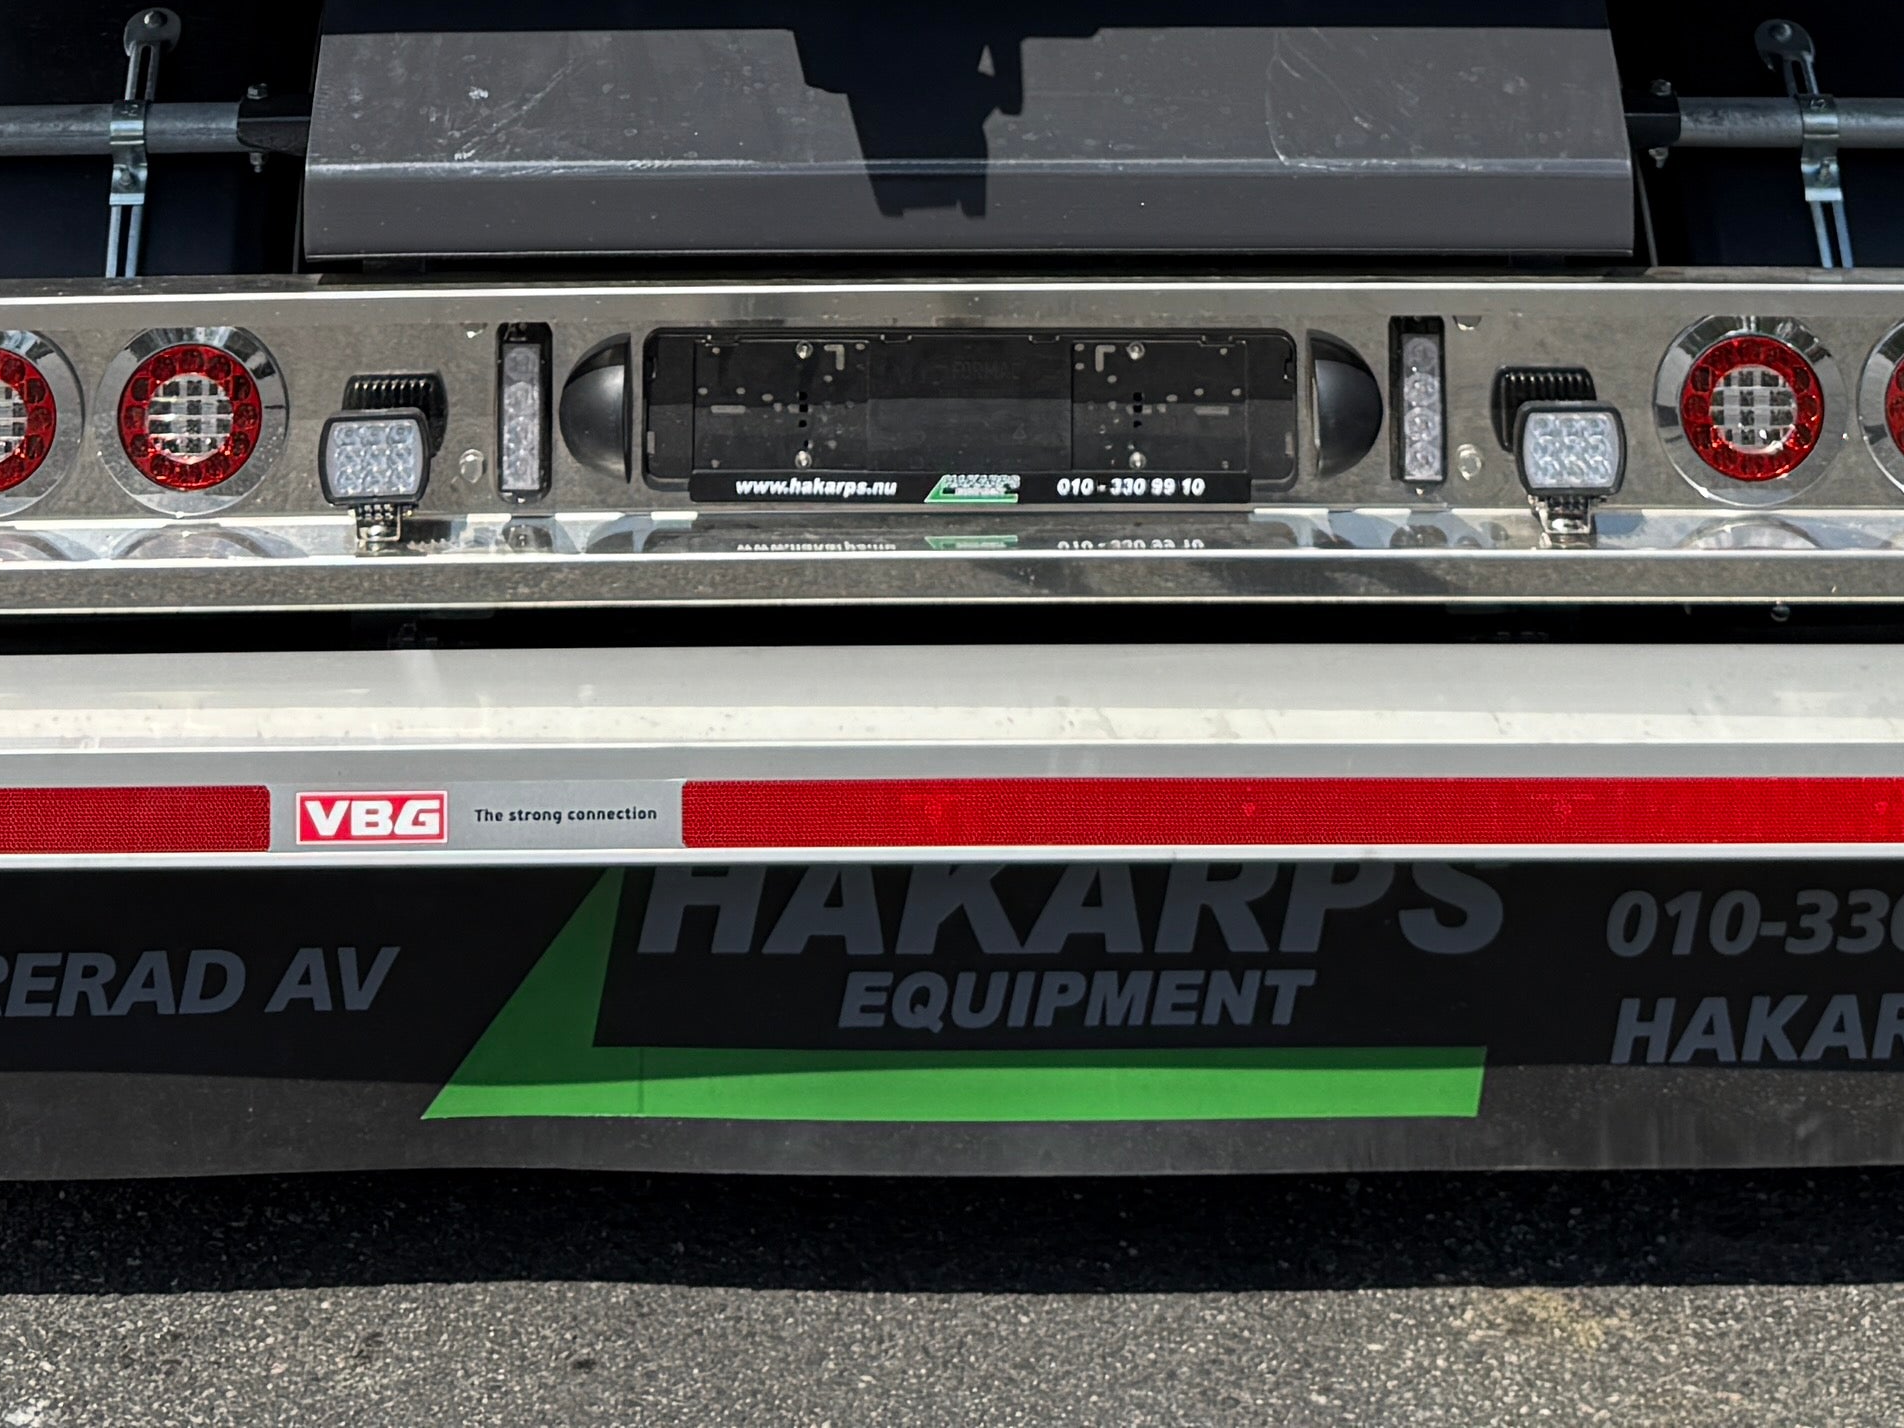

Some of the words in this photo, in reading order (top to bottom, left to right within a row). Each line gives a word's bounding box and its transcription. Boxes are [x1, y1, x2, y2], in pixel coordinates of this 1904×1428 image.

[735, 477, 898, 498] www.hakarps.nu
[1109, 478, 1147, 496] 330
[1151, 478, 1176, 496] 99
[1181, 478, 1206, 496] 10
[304, 800, 441, 836] VBG
[474, 809, 503, 822] The
[508, 808, 562, 824] strong
[568, 806, 657, 821] connection
[636, 861, 1506, 956] HAKARPS
[263, 947, 401, 1013] AV
[837, 969, 1318, 1034] EQUIPMENT
